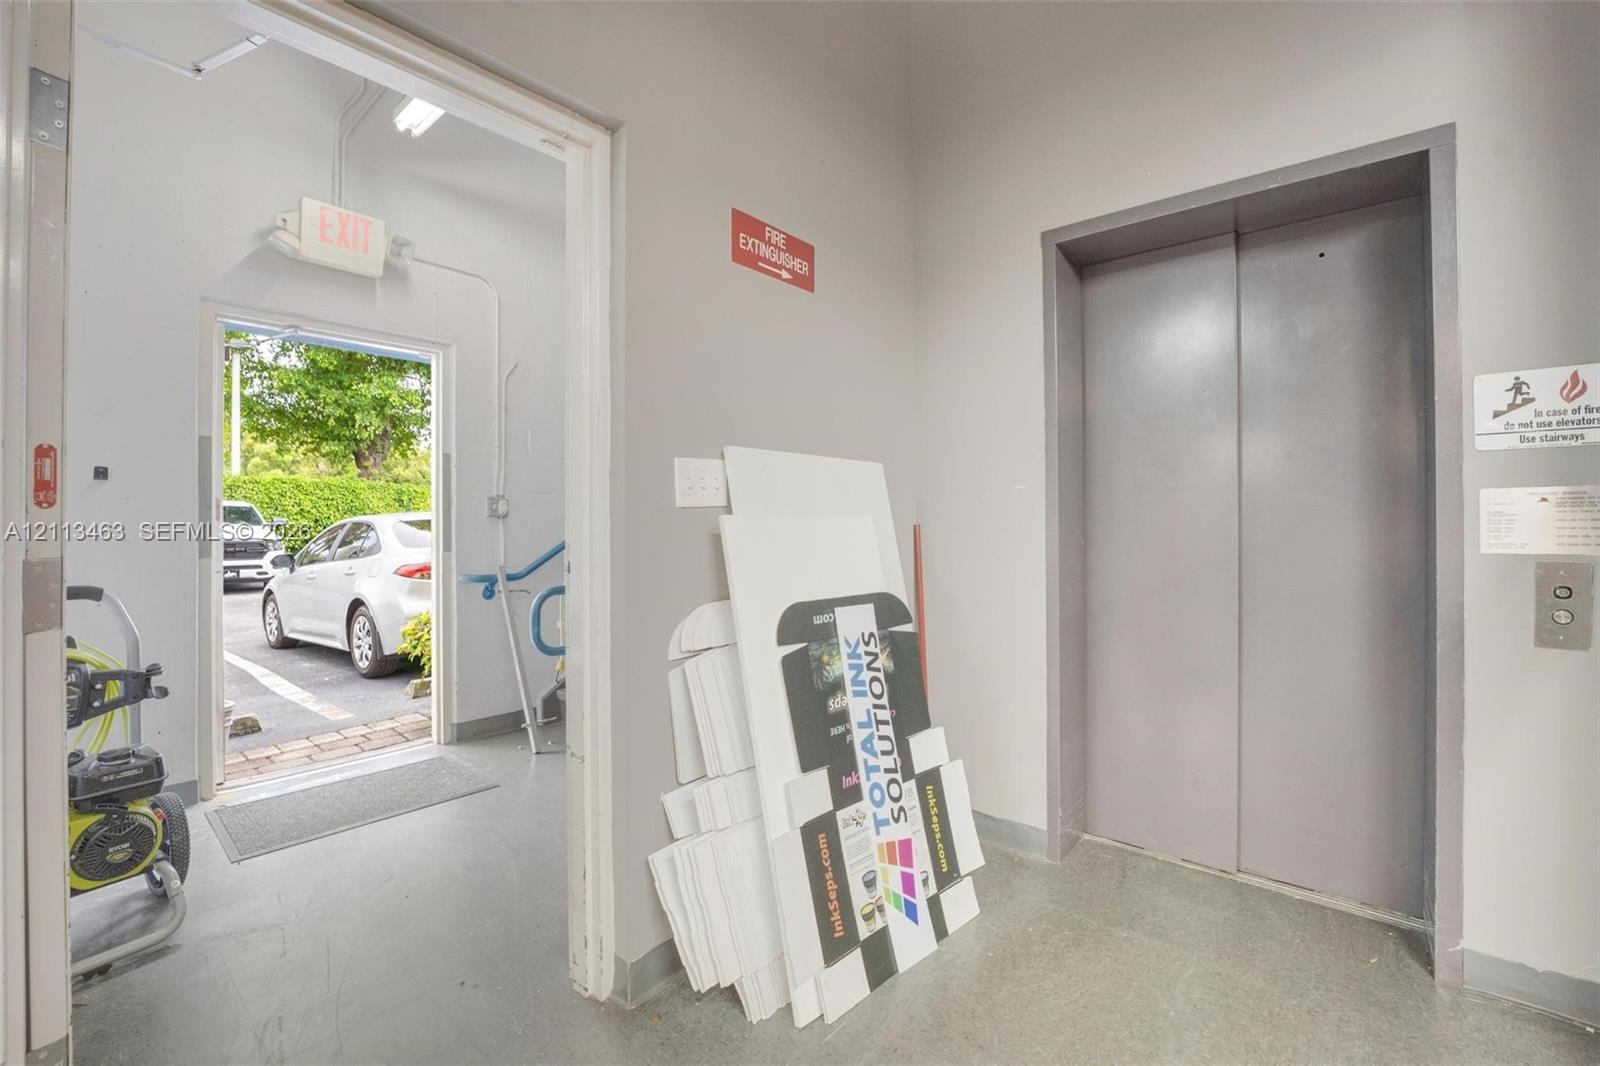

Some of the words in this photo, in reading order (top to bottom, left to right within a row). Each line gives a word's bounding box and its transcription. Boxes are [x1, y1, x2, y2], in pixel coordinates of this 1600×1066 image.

[319, 206, 373, 254] EXIT
[765, 226, 787, 250] FIRE
[739, 232, 809, 277] EXTINGUISHER
[1503, 421, 1515, 430] do
[1518, 420, 1533, 429] not
[1536, 420, 1553, 428] use
[1556, 416, 1600, 427] elevators
[1534, 409, 1543, 418] In
[1546, 408, 1569, 417] case
[1571, 405, 1581, 415] of
[1584, 404, 1600, 414] fire
[1519, 434, 1537, 444] Use
[1539, 432, 1585, 442] stairways
[844, 635, 869, 698] INK
[862, 631, 908, 824] SOLUTIONS
[857, 708, 890, 836] TOTAL
[818, 832, 844, 938] InkSeps.com
